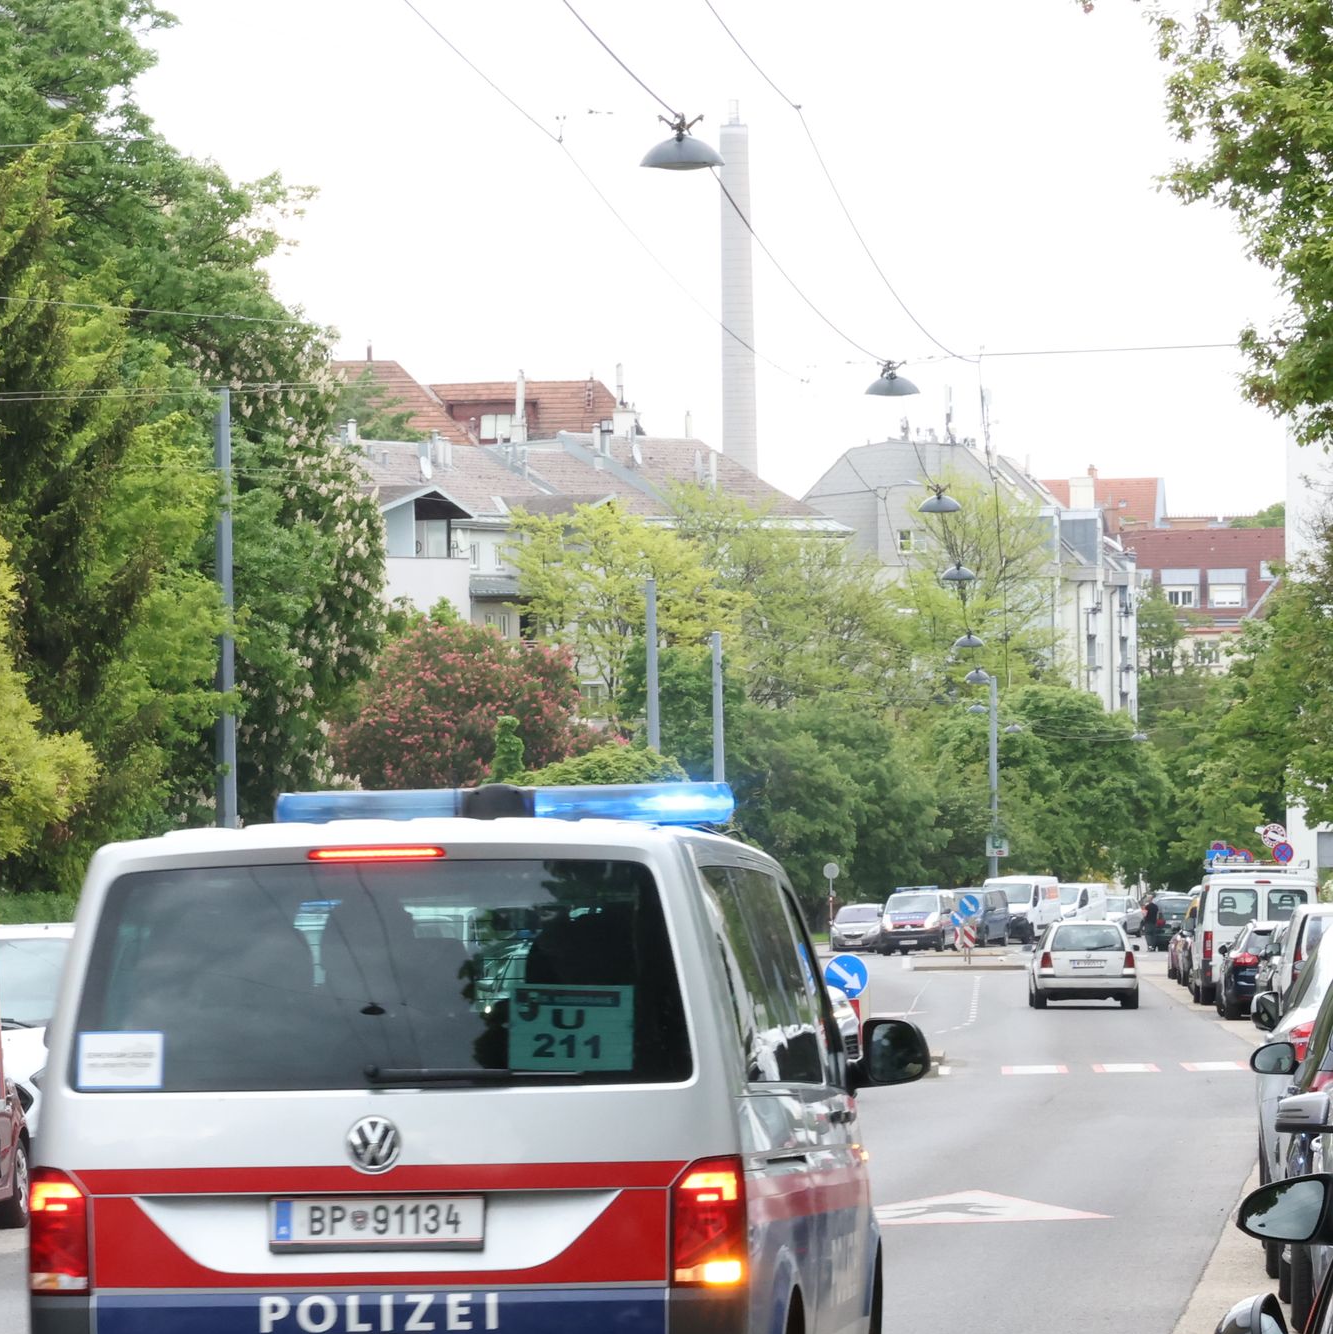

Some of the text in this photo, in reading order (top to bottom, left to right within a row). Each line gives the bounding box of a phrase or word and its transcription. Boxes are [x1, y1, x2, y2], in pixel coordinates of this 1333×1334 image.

[551, 1008, 585, 1030] U
[532, 1033, 601, 1059] 211
[309, 1203, 461, 1236] BP 91134
[259, 1292, 499, 1334] POLIZEI
